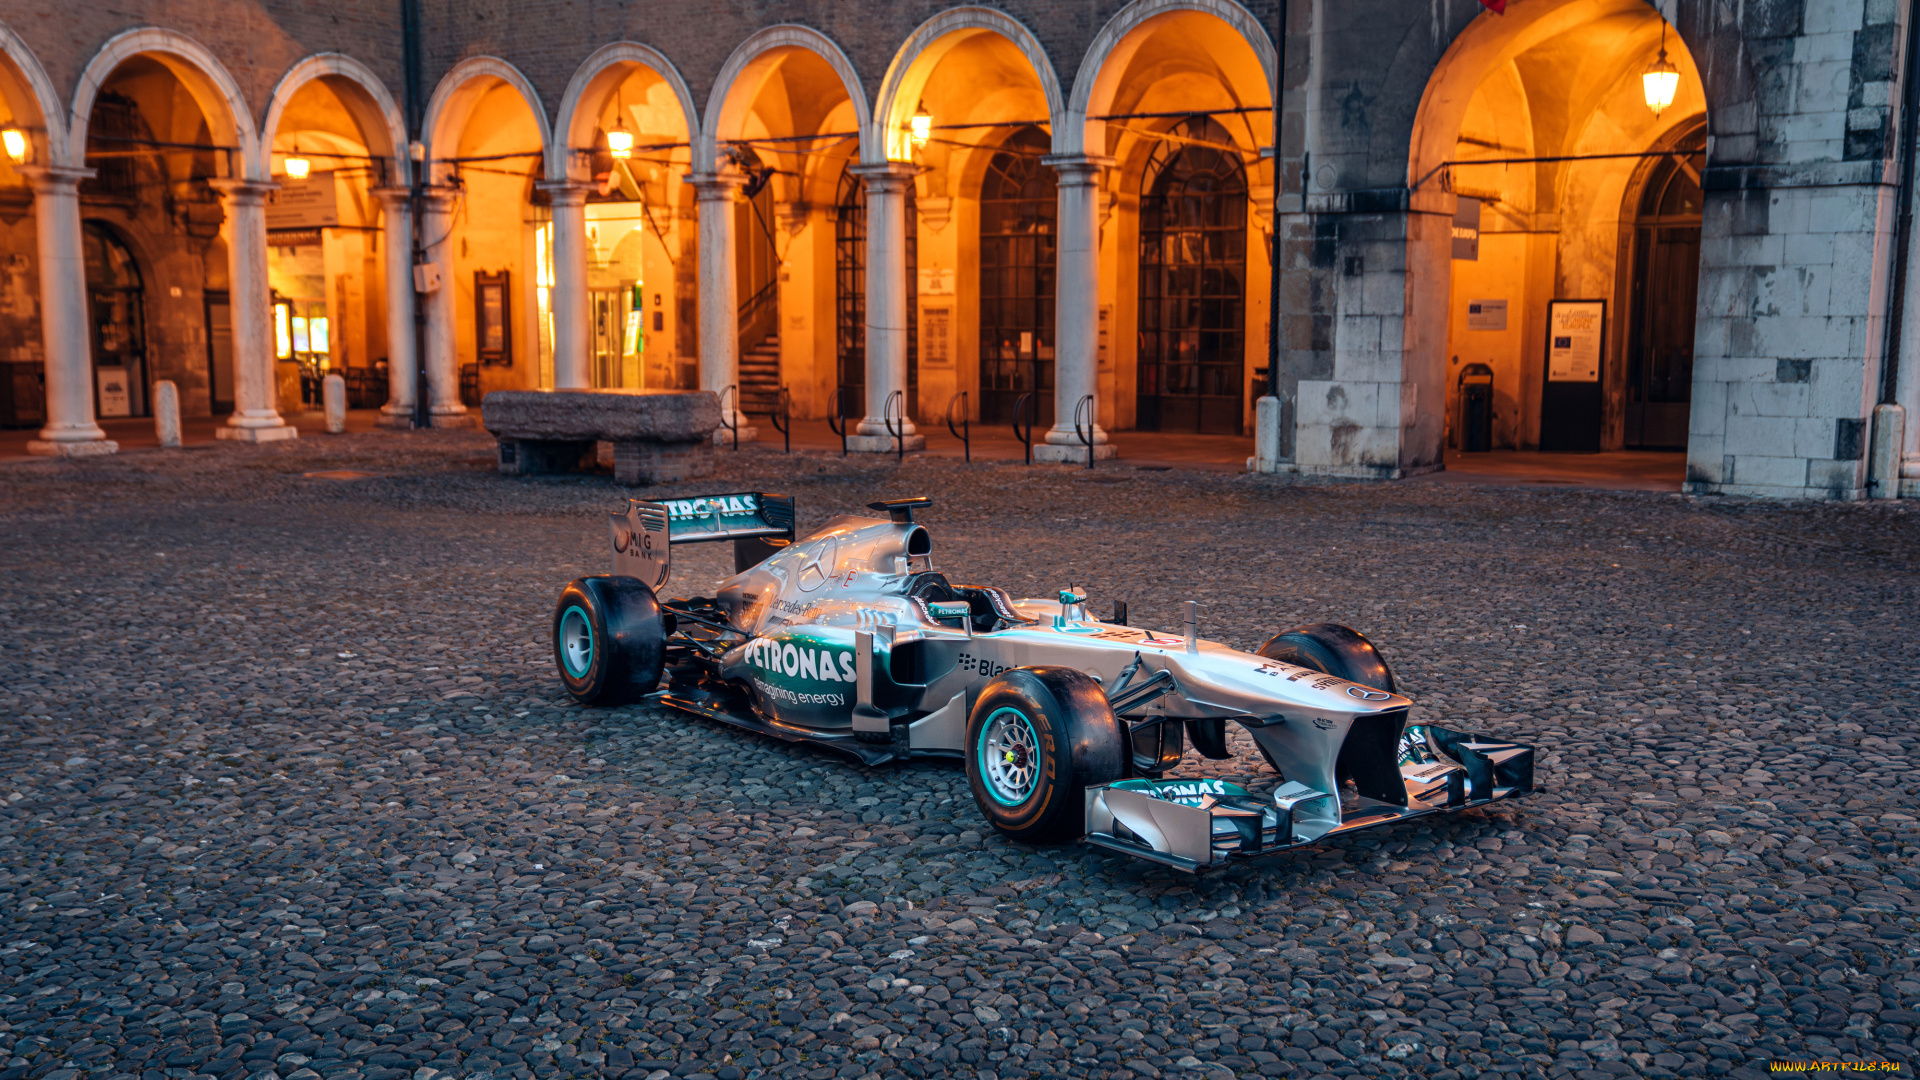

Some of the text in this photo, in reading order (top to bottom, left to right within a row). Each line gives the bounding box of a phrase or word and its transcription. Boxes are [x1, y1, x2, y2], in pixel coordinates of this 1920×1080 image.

[629, 531, 651, 549] MIG
[630, 550, 653, 560] BANK
[770, 595, 824, 619] Mercedes-Benz
[745, 637, 857, 683] PETRONAS
[979, 660, 1018, 678] Bla
[798, 692, 845, 706] energy
